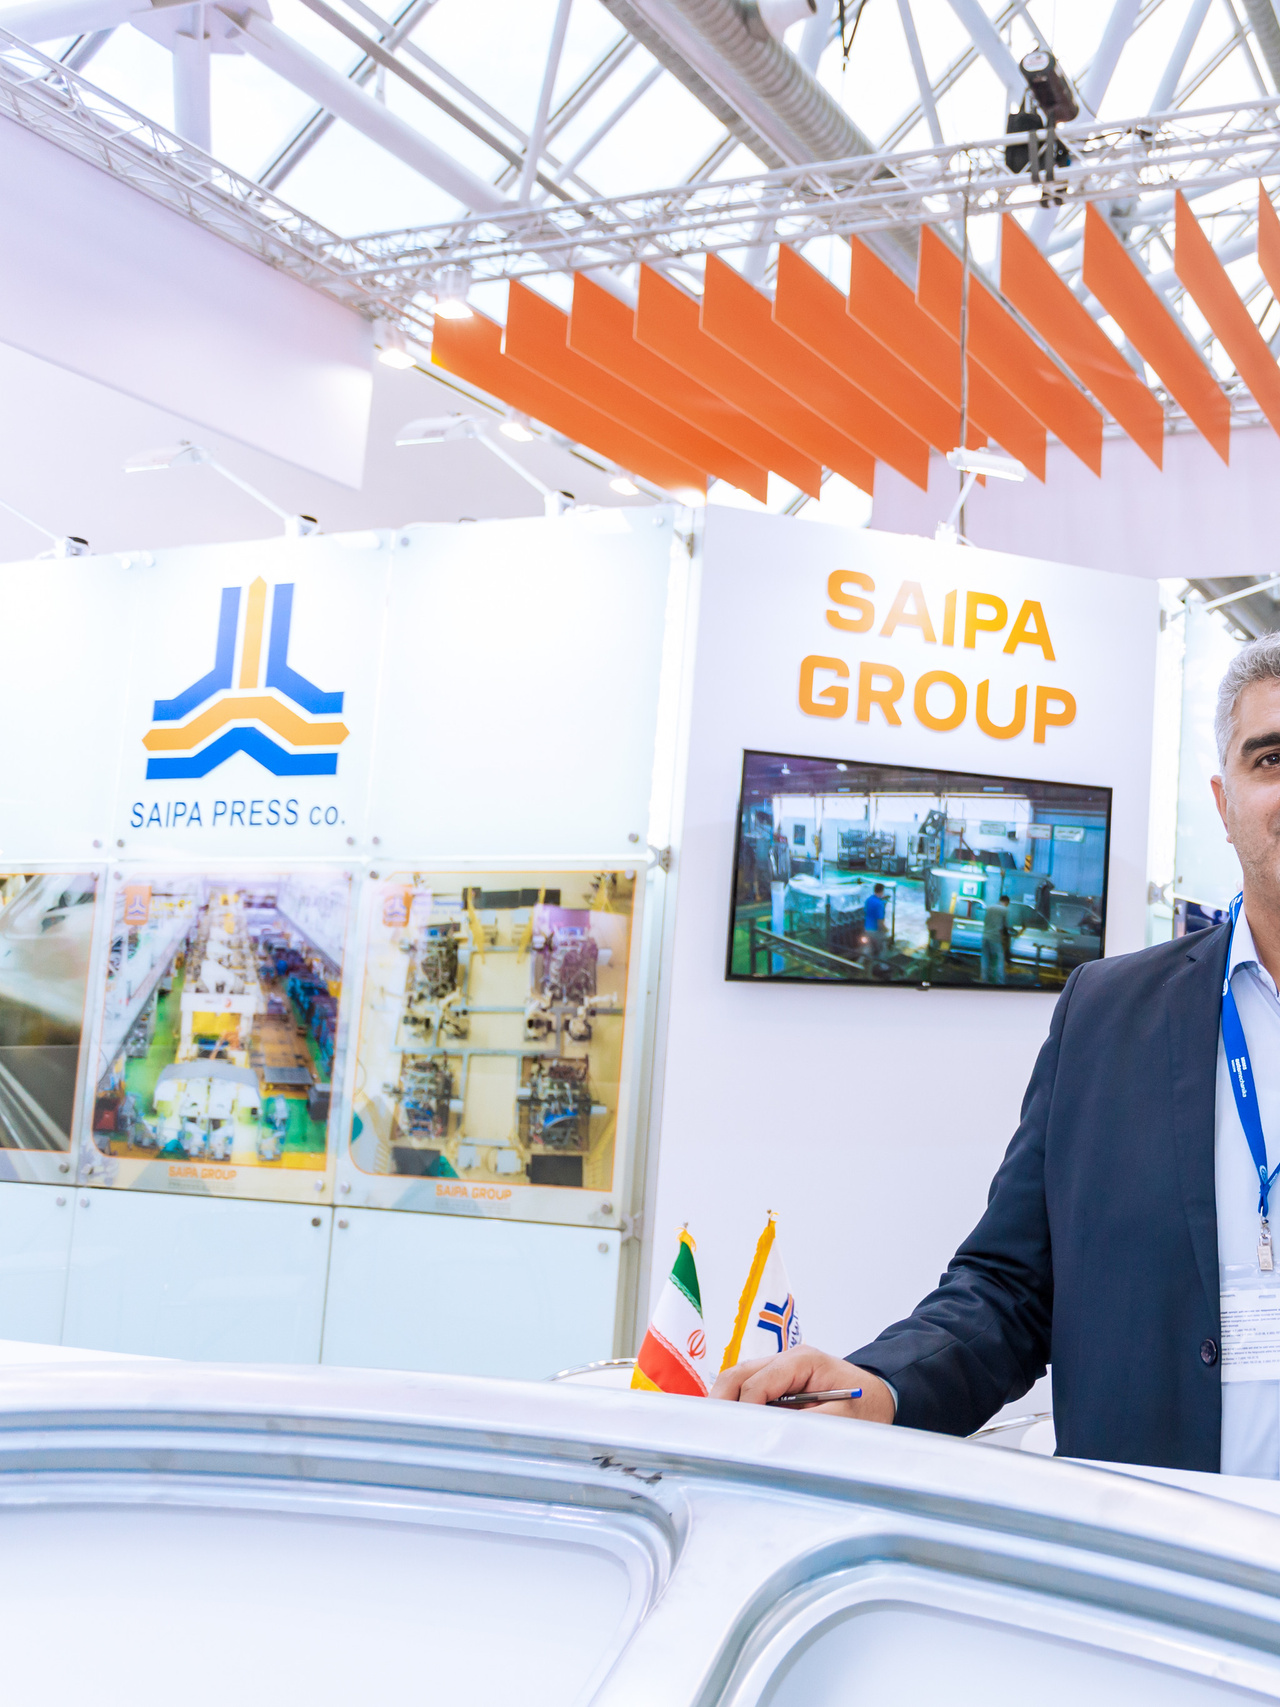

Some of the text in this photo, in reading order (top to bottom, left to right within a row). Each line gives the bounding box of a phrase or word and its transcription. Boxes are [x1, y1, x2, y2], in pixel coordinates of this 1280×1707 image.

[826, 569, 1056, 662] SAIPA
[798, 654, 1077, 744] GROUP
[130, 801, 202, 828] SAIPA
[212, 798, 298, 826] PRESS
[168, 1165, 237, 1180] SAIPA GROUP
[435, 1184, 512, 1201] SAIPA GROUP
